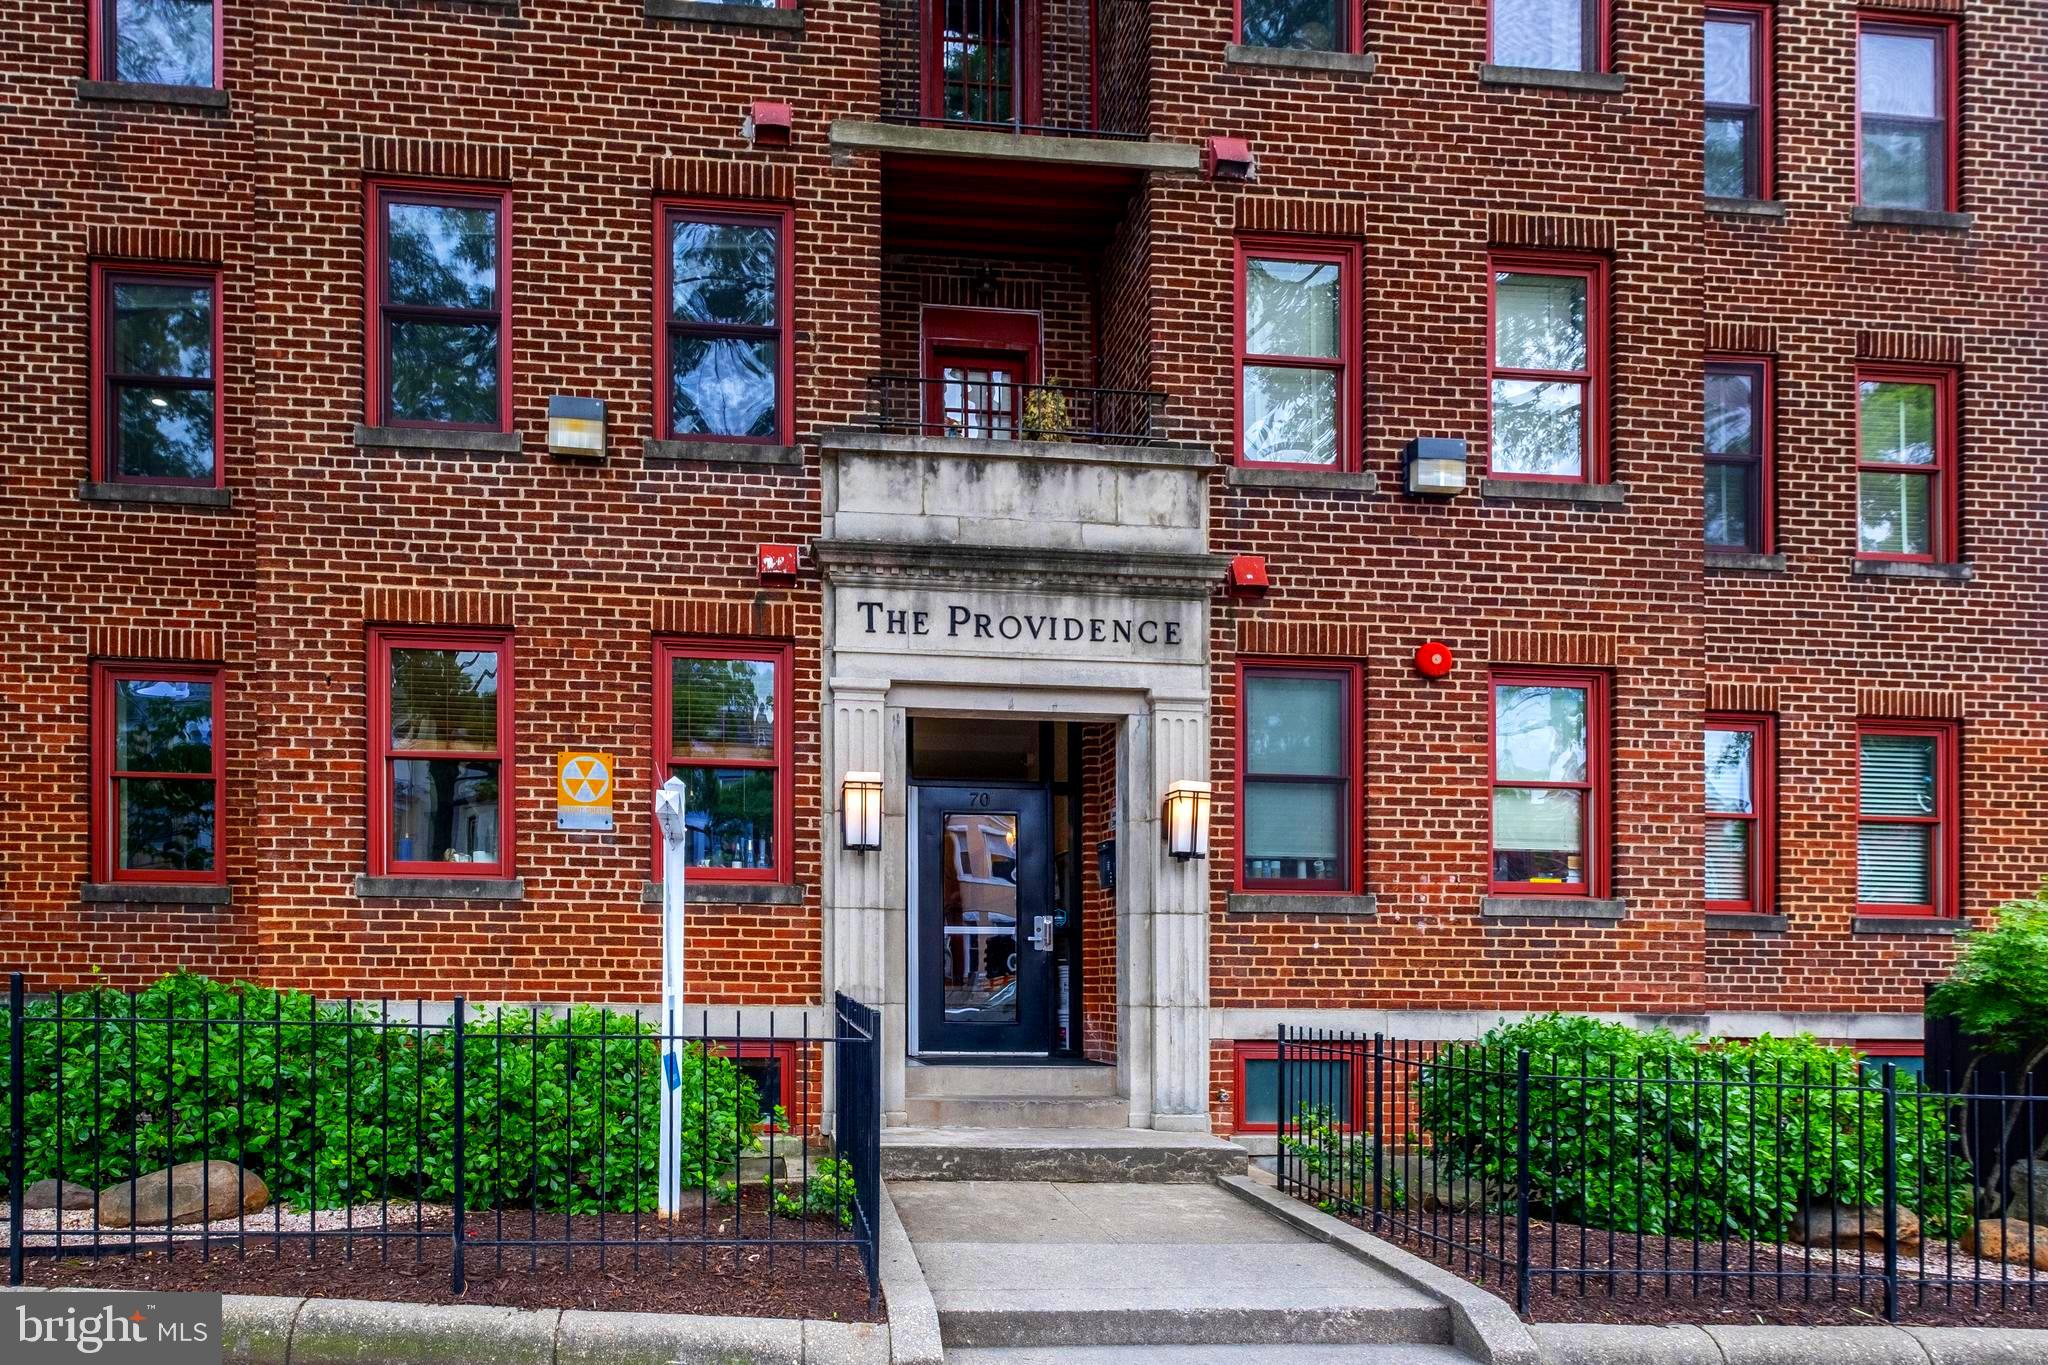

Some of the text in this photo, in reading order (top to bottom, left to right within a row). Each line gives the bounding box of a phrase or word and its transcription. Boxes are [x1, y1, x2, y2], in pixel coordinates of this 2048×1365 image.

[857, 601, 1183, 646] THE PROVIDENCE
[969, 791, 990, 808] 70
